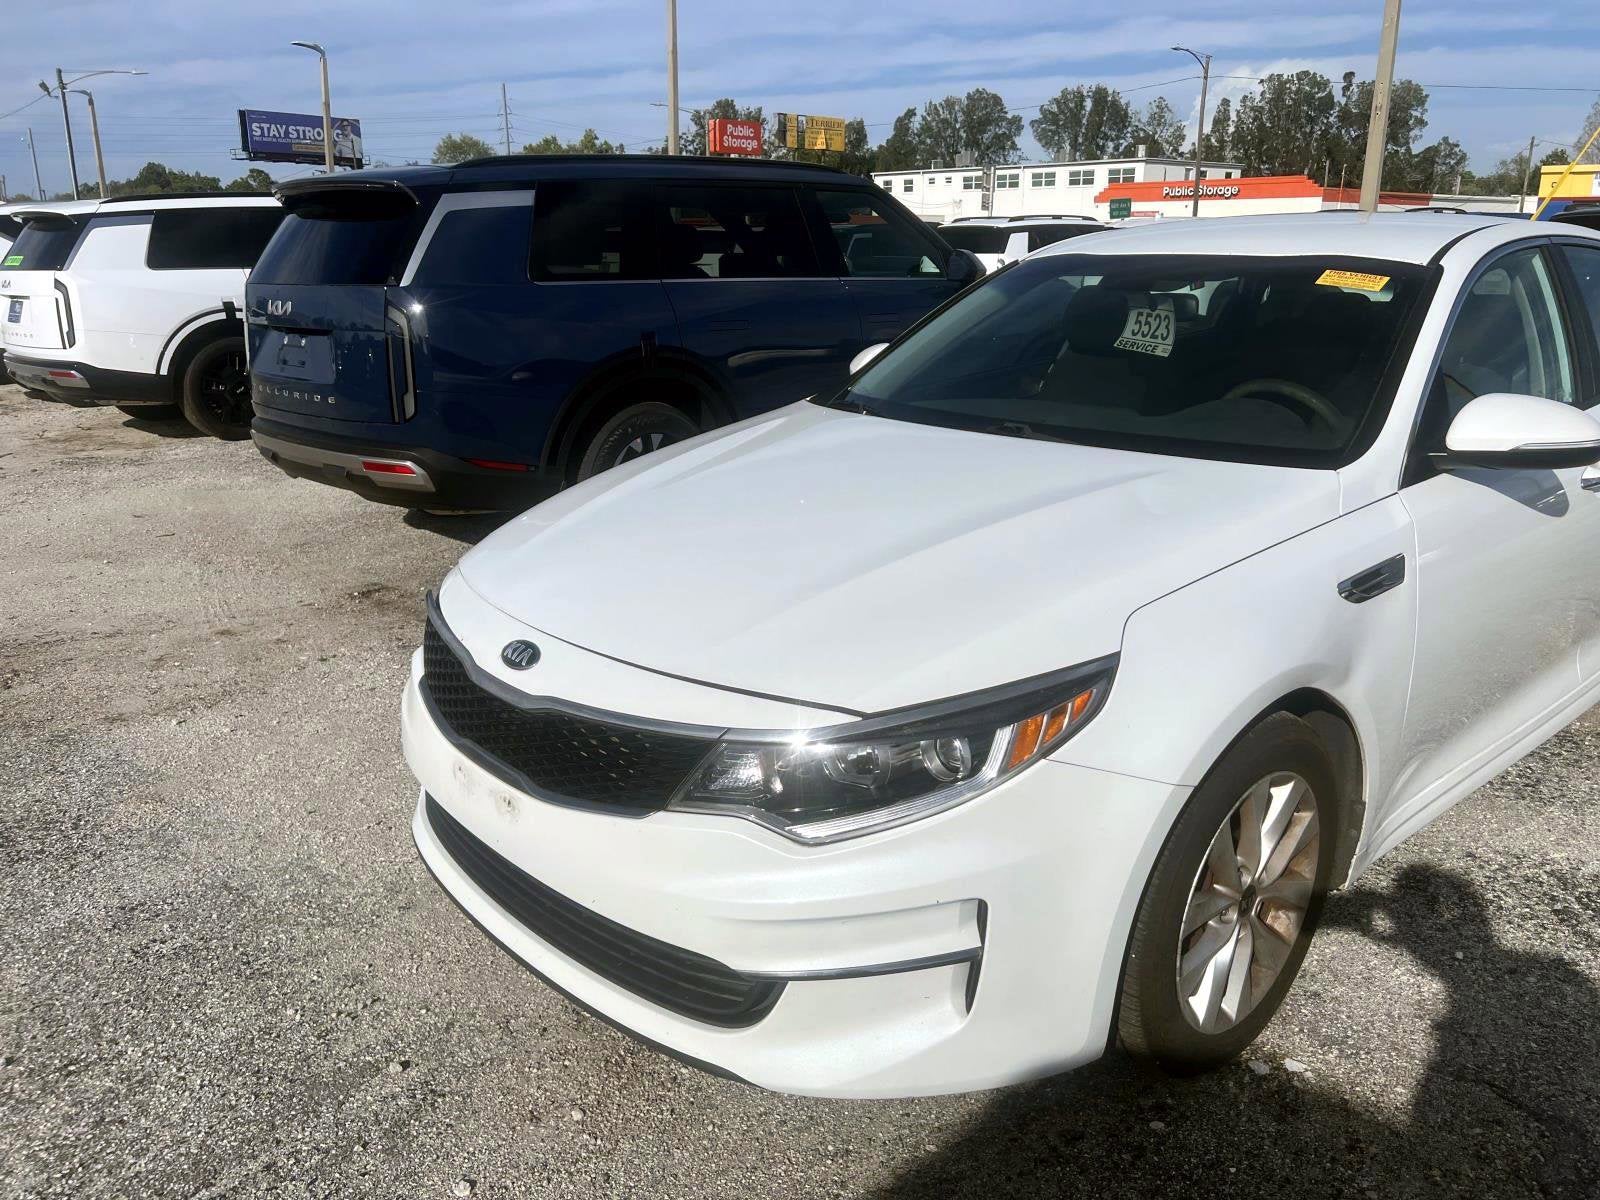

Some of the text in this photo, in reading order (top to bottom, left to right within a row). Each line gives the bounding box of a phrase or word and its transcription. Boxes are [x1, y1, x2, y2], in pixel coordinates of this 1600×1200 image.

[251, 122, 342, 142] STAY STROG
[727, 124, 755, 137] Public
[723, 136, 758, 151] Storage
[1162, 185, 1240, 198] Public Storage
[267, 299, 292, 316] KIA
[1131, 311, 1171, 342] 5523
[1116, 339, 1160, 354] SERVICE
[503, 642, 533, 666] KIA
